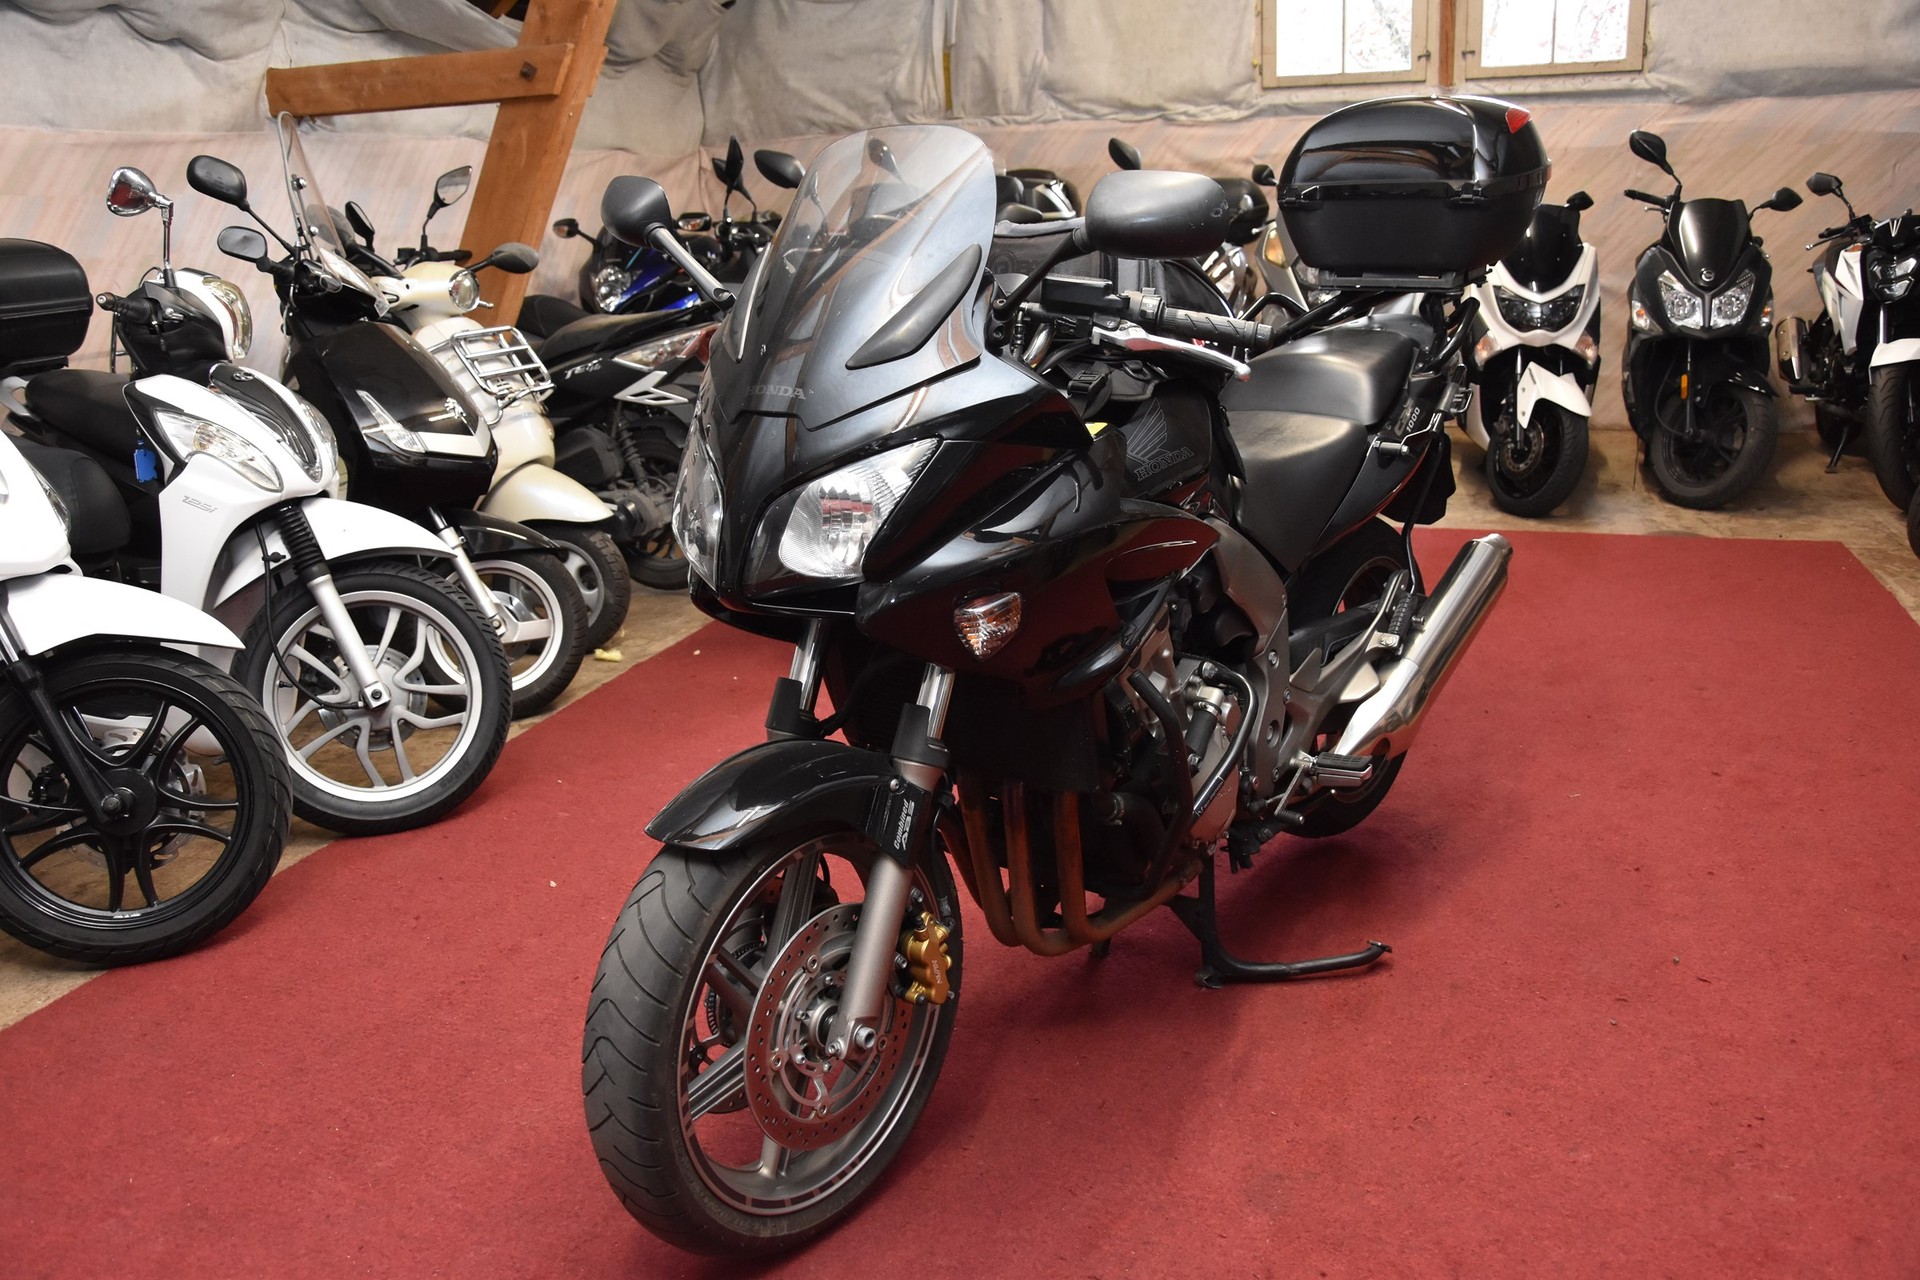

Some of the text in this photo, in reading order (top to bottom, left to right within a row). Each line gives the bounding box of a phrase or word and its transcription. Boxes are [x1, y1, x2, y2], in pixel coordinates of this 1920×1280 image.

[747, 384, 806, 400] HONDA
[1406, 406, 1420, 432] 1000
[1134, 446, 1194, 481] HONDA
[893, 798, 909, 850] Combined
